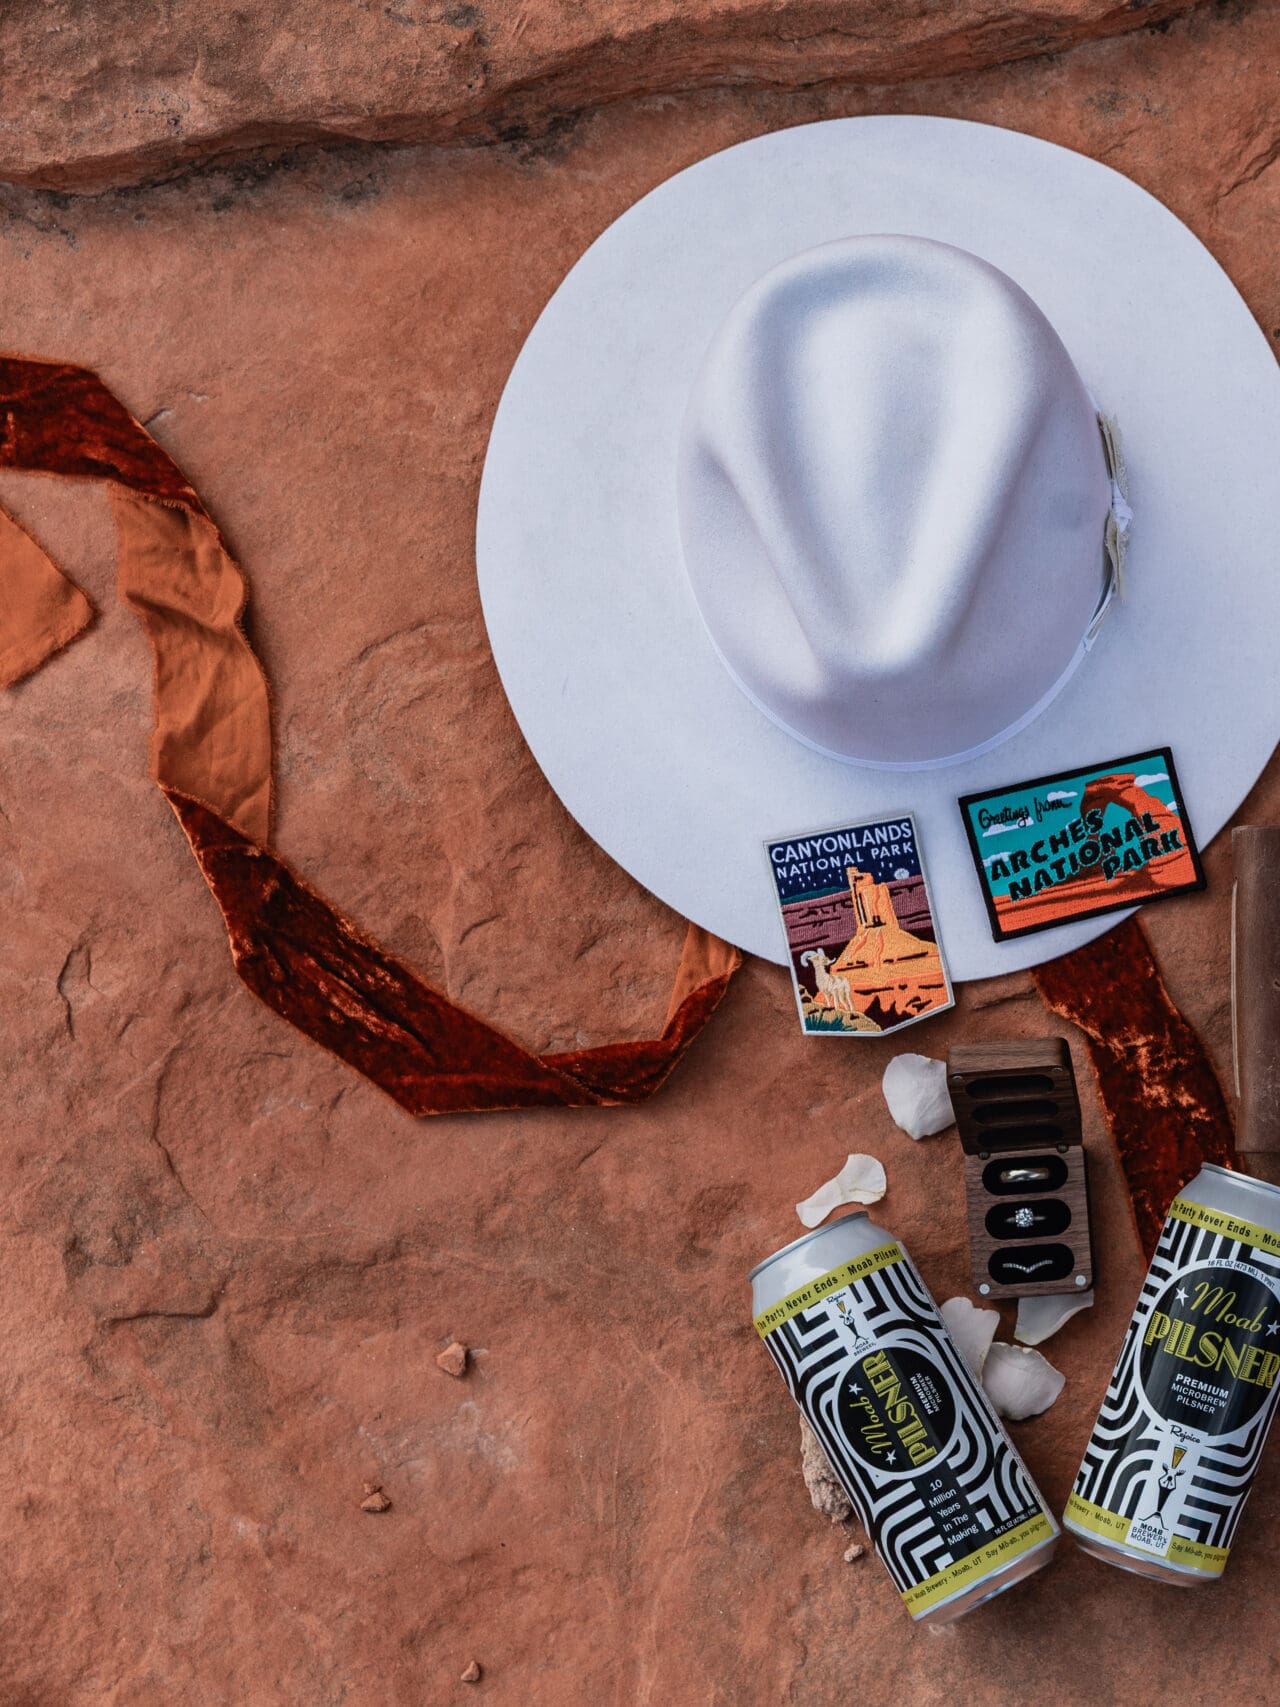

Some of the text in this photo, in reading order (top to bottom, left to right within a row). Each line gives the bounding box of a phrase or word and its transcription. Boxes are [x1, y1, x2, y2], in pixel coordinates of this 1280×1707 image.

[978, 806, 1030, 829] Greetings
[771, 822, 912, 863] CANYONLANDS
[991, 808, 1104, 881] ARCHES
[1008, 811, 1161, 902] NATIONAL
[1101, 828, 1184, 882] PARK
[776, 841, 913, 879] NATIONAL PARK
[1178, 1203, 1197, 1220] Party
[1199, 1210, 1224, 1228] Never
[1226, 1221, 1251, 1238] Ends
[1216, 1259, 1225, 1267] FL
[1224, 1260, 1234, 1268] OZ
[765, 1310, 786, 1324] Party
[785, 1292, 812, 1311] Never
[813, 1276, 839, 1295] Ends
[847, 1258, 873, 1276] Moab
[873, 1247, 900, 1263] Pilsner
[1190, 1281, 1268, 1333] Moab
[1144, 1310, 1280, 1389] PILSNER
[909, 1376, 934, 1415] PREMIUM
[915, 1372, 940, 1412] MICROBREW
[924, 1375, 942, 1403] PILSNER
[1171, 1383, 1228, 1408] MICROBREW
[1175, 1373, 1230, 1399] PREMIUM
[862, 1349, 938, 1466] PILSNER
[1176, 1395, 1216, 1414] PILSNER
[849, 1396, 893, 1454] Moab
[1170, 1424, 1201, 1444] Rejoice
[928, 1487, 957, 1508] Million
[929, 1479, 943, 1492] 10
[936, 1502, 961, 1518] Years
[942, 1513, 969, 1533] In The
[1094, 1512, 1113, 1527] Moab,
[1115, 1522, 1126, 1531] UT
[947, 1523, 979, 1546] Making
[1130, 1533, 1166, 1549] MOAB, UT
[1140, 1522, 1164, 1536] MOAB
[925, 1576, 949, 1594] Brewery
[951, 1565, 973, 1579] Moab,
[972, 1555, 983, 1567] UT
[985, 1548, 999, 1560] Say
